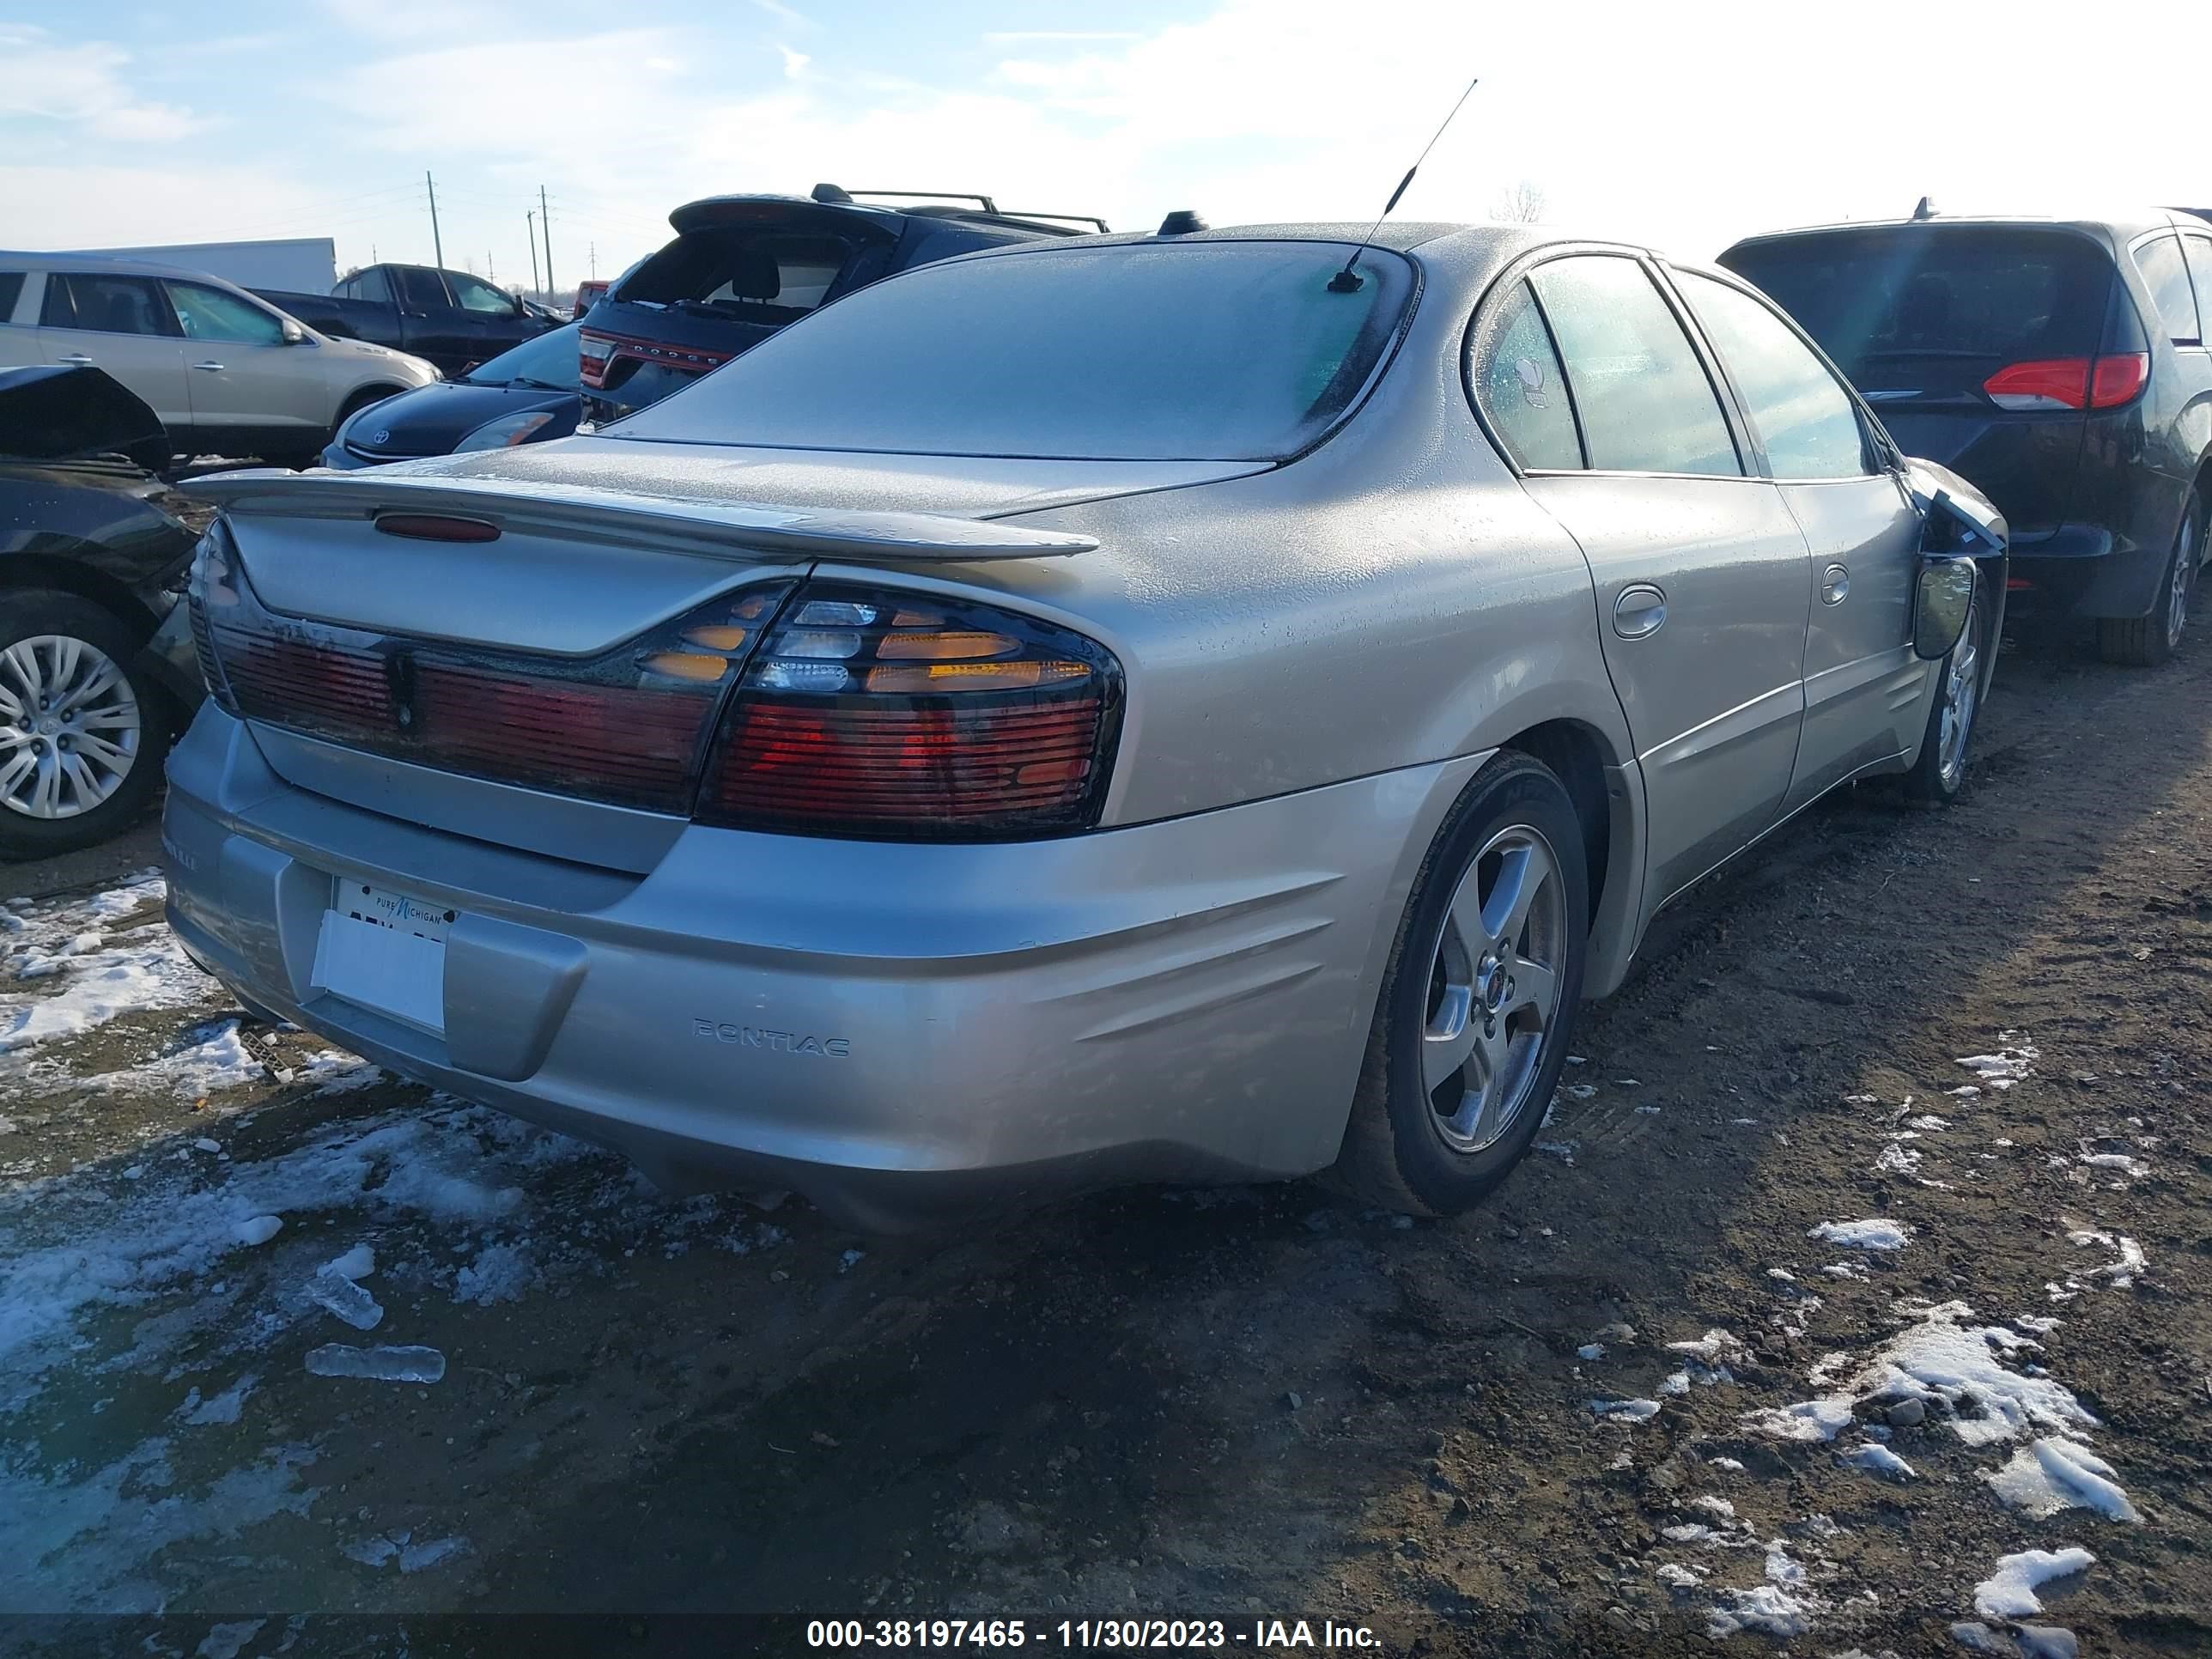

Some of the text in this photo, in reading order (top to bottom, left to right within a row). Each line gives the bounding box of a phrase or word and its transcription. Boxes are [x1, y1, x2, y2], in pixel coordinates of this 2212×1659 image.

[377, 896, 395, 911] PURE
[387, 896, 441, 926] MICHIGAN
[693, 1017, 851, 1058] PONTIAC
